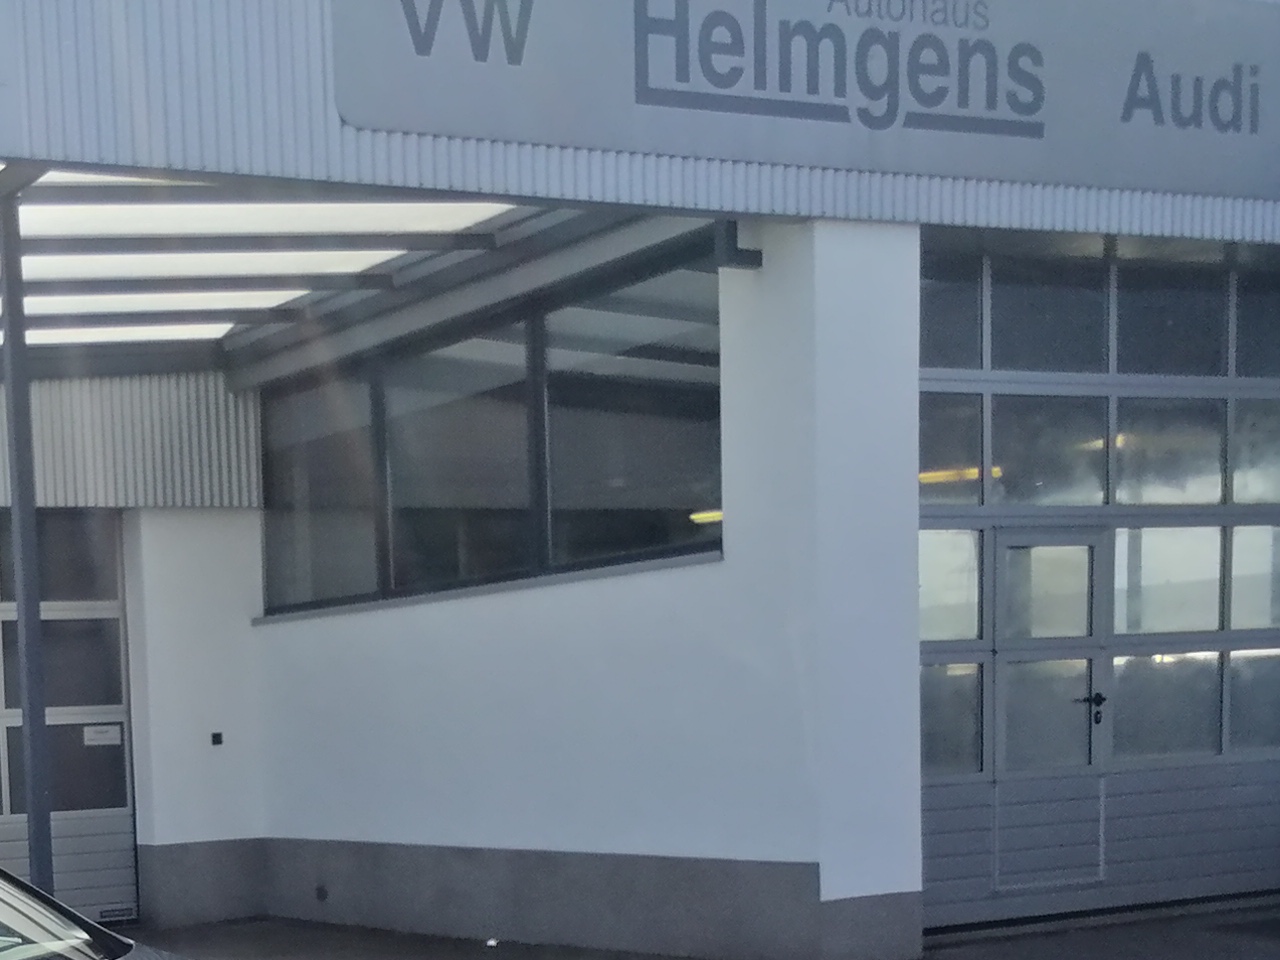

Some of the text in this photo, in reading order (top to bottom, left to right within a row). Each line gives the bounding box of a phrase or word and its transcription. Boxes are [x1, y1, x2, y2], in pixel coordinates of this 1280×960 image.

[400, 0, 535, 66] VW
[634, 0, 1046, 131] Helmgens
[1120, 50, 1260, 135] Audi
